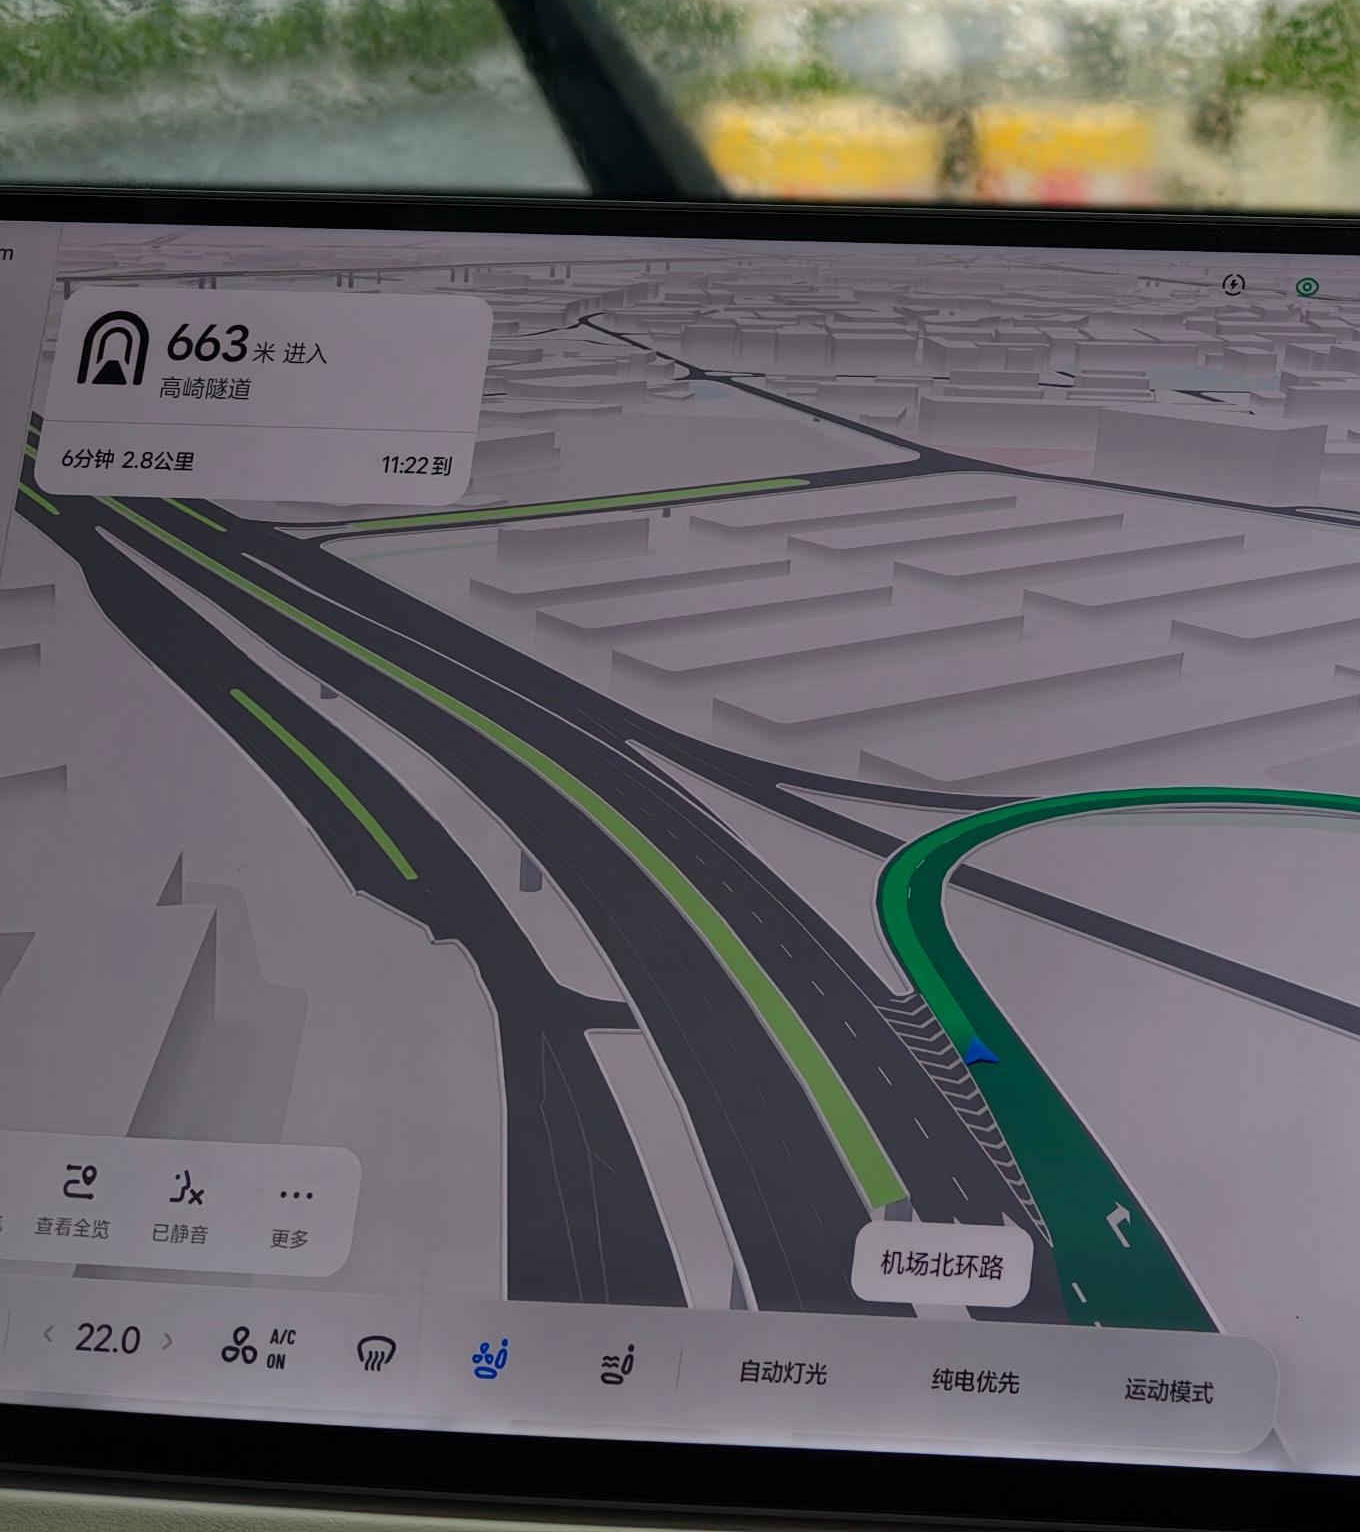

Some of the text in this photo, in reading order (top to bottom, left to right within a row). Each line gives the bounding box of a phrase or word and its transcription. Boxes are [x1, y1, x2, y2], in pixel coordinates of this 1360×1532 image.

[283, 343, 327, 364] 进入
[160, 376, 251, 400] 高崎隧道
[62, 449, 194, 470] 6分钟 2.8公里
[383, 456, 452, 476] 11:22到
[35, 1217, 110, 1239] 查看全览
[153, 1224, 208, 1244] 已静音
[271, 1229, 307, 1249] 更多
[881, 1250, 1003, 1280] 机场北环路
[76, 1323, 140, 1354] 22.0
[270, 1329, 296, 1344] A/C
[267, 1354, 285, 1369] ON
[740, 1359, 827, 1385] 自动灯光
[931, 1368, 1019, 1394] 纯电优先
[1125, 1378, 1214, 1404] 运动模式
